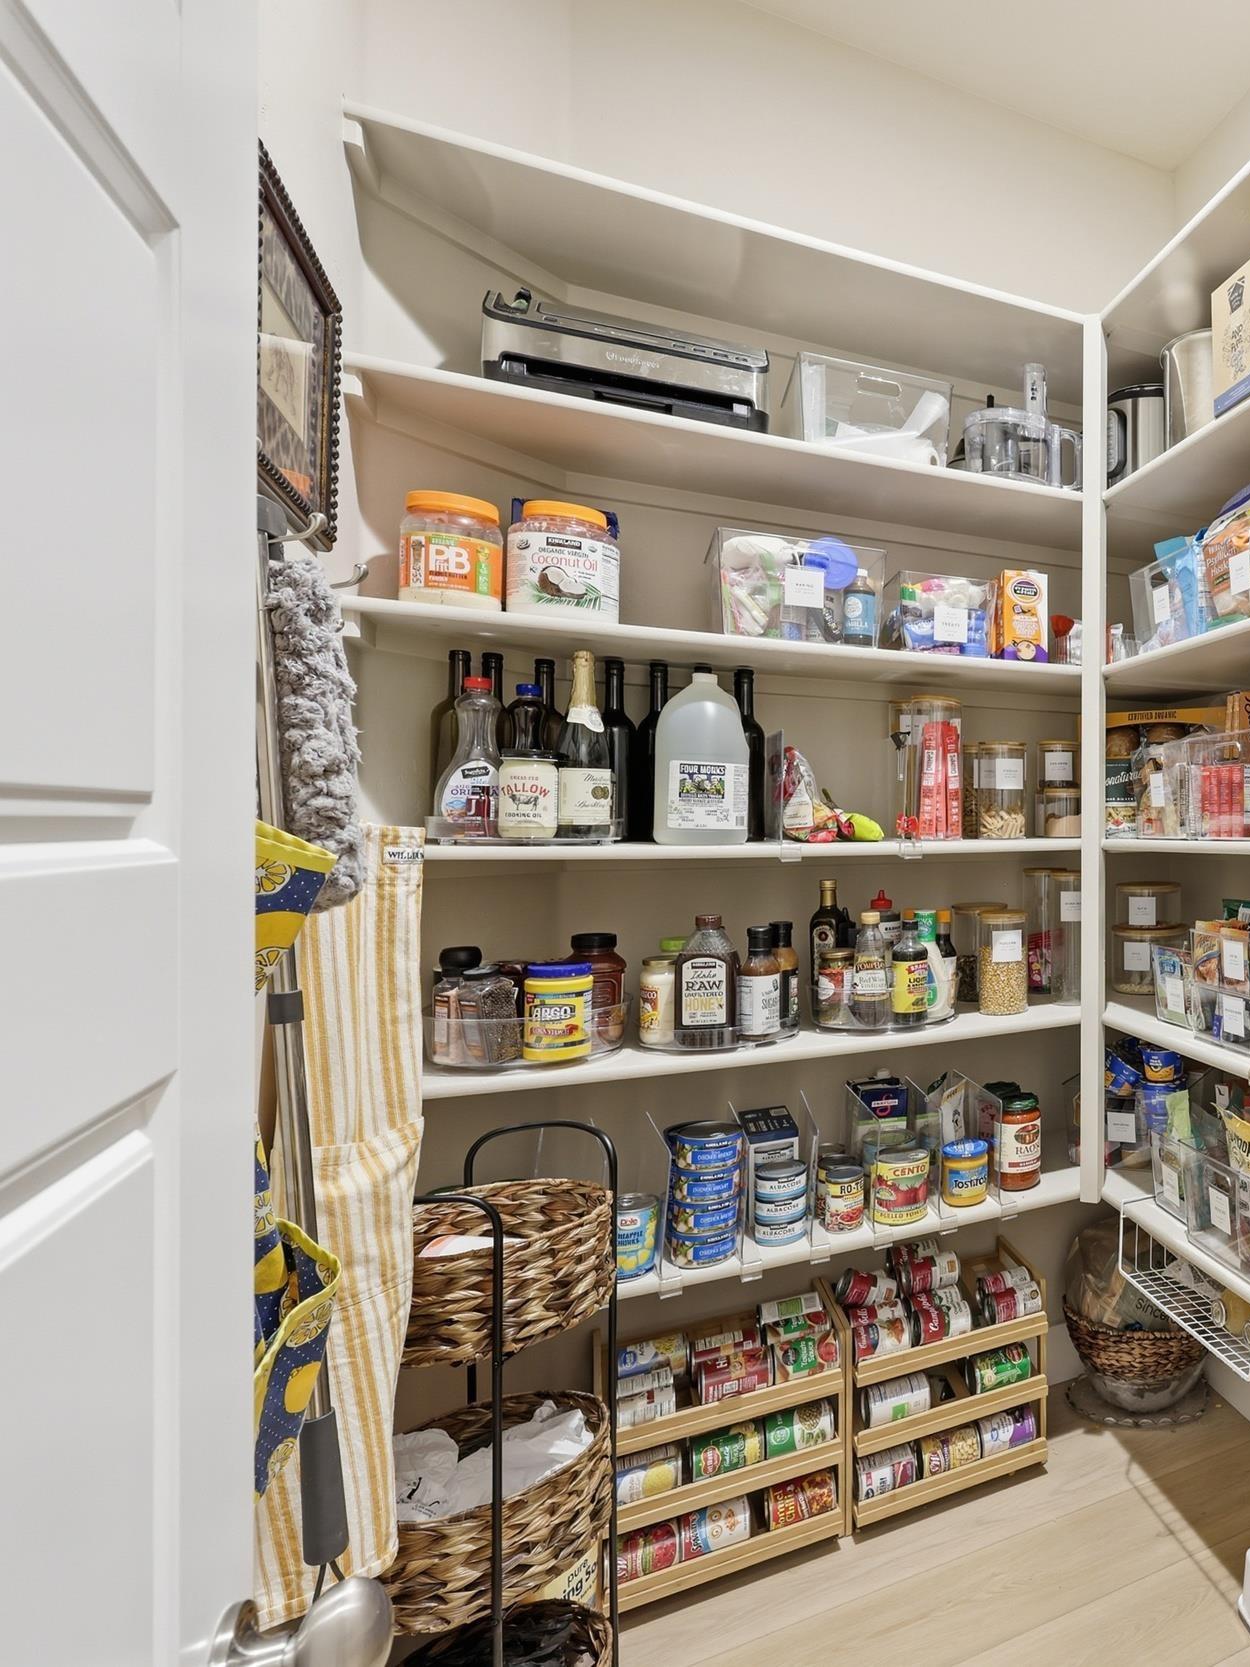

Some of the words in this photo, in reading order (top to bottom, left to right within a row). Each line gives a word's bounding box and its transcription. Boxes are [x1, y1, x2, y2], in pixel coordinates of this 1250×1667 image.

[429, 544, 471, 574] PB
[531, 552, 580, 567] Coconut
[584, 558, 598, 571] Oil
[680, 764, 698, 773] FOUR
[502, 783, 550, 798] TALLOW
[690, 969, 717, 979] Idaho
[684, 980, 723, 992] RAW
[684, 991, 724, 999] UNFILTERED
[684, 998, 723, 1011] HONEY
[533, 1006, 571, 1020] ARGO
[892, 1165, 926, 1177] CENTO
[769, 1180, 802, 1191] ALBACORE
[954, 1174, 987, 1189] TOSTITOS
[766, 1203, 799, 1213] ALBACORE
[762, 1227, 795, 1236] ALBACORE
[775, 1490, 785, 1524] ormel
[784, 1494, 795, 1522] Chili
[567, 1558, 589, 1585] pure
[561, 1579, 584, 1602] ing
